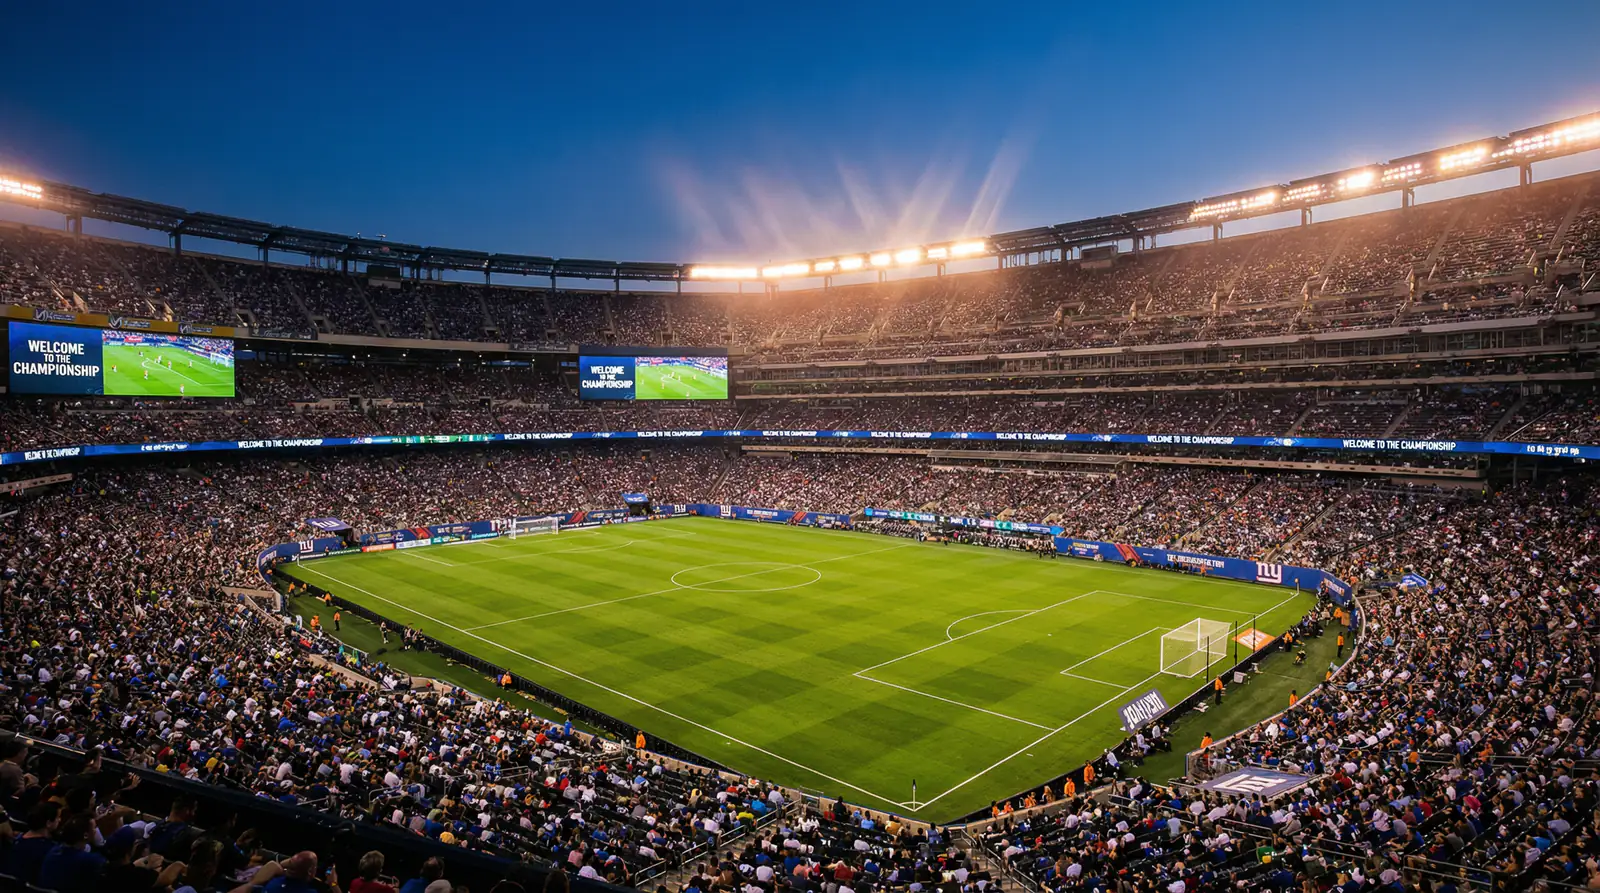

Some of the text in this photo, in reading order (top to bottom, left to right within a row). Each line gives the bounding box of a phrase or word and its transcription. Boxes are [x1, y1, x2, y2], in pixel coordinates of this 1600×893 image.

[28, 340, 84, 355] WELCOME
[44, 354, 71, 364] TO THE
[14, 362, 100, 377] CHAMPIONSHIP
[591, 366, 625, 374] WELCOME
[582, 380, 633, 388] CHAMPIONSHIP
[1343, 440, 1375, 448] WELCOME
[1376, 440, 1385, 449] TO
[1386, 440, 1400, 449] THE
